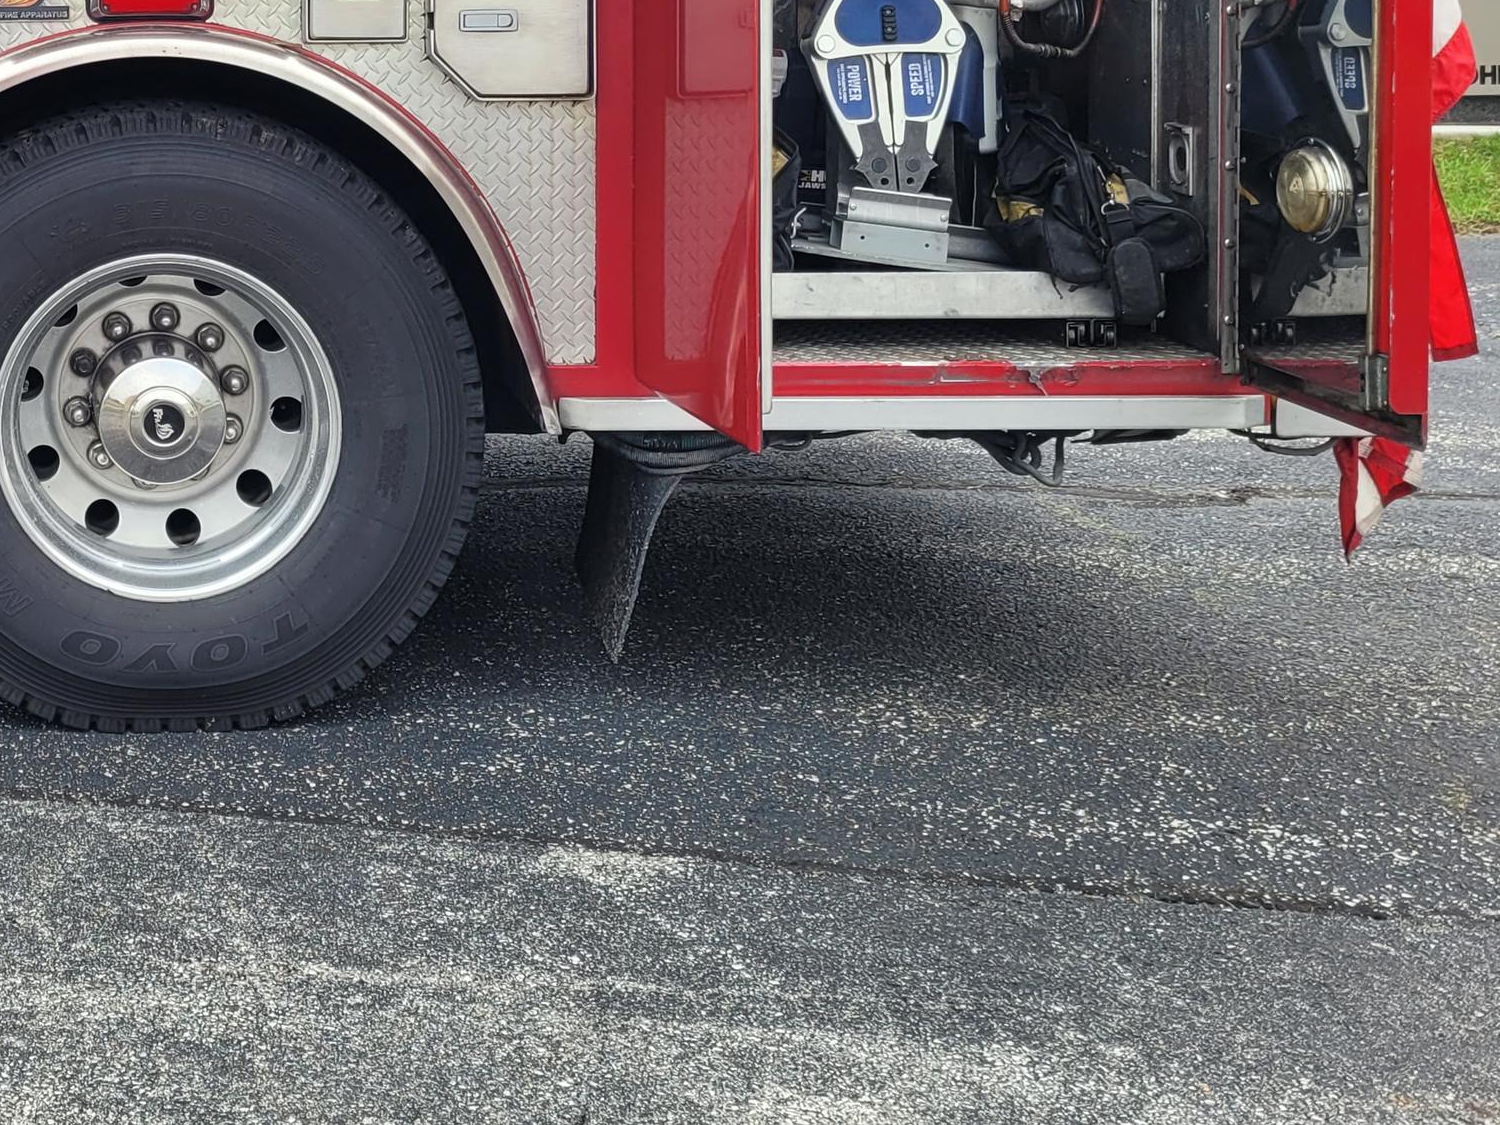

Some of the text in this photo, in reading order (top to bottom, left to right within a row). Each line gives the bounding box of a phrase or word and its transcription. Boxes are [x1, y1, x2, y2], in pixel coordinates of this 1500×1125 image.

[20, 10, 68, 18] APPARATUS
[847, 64, 862, 102] POWER
[908, 62, 925, 96] SPEED
[59, 612, 309, 673] TOYO
